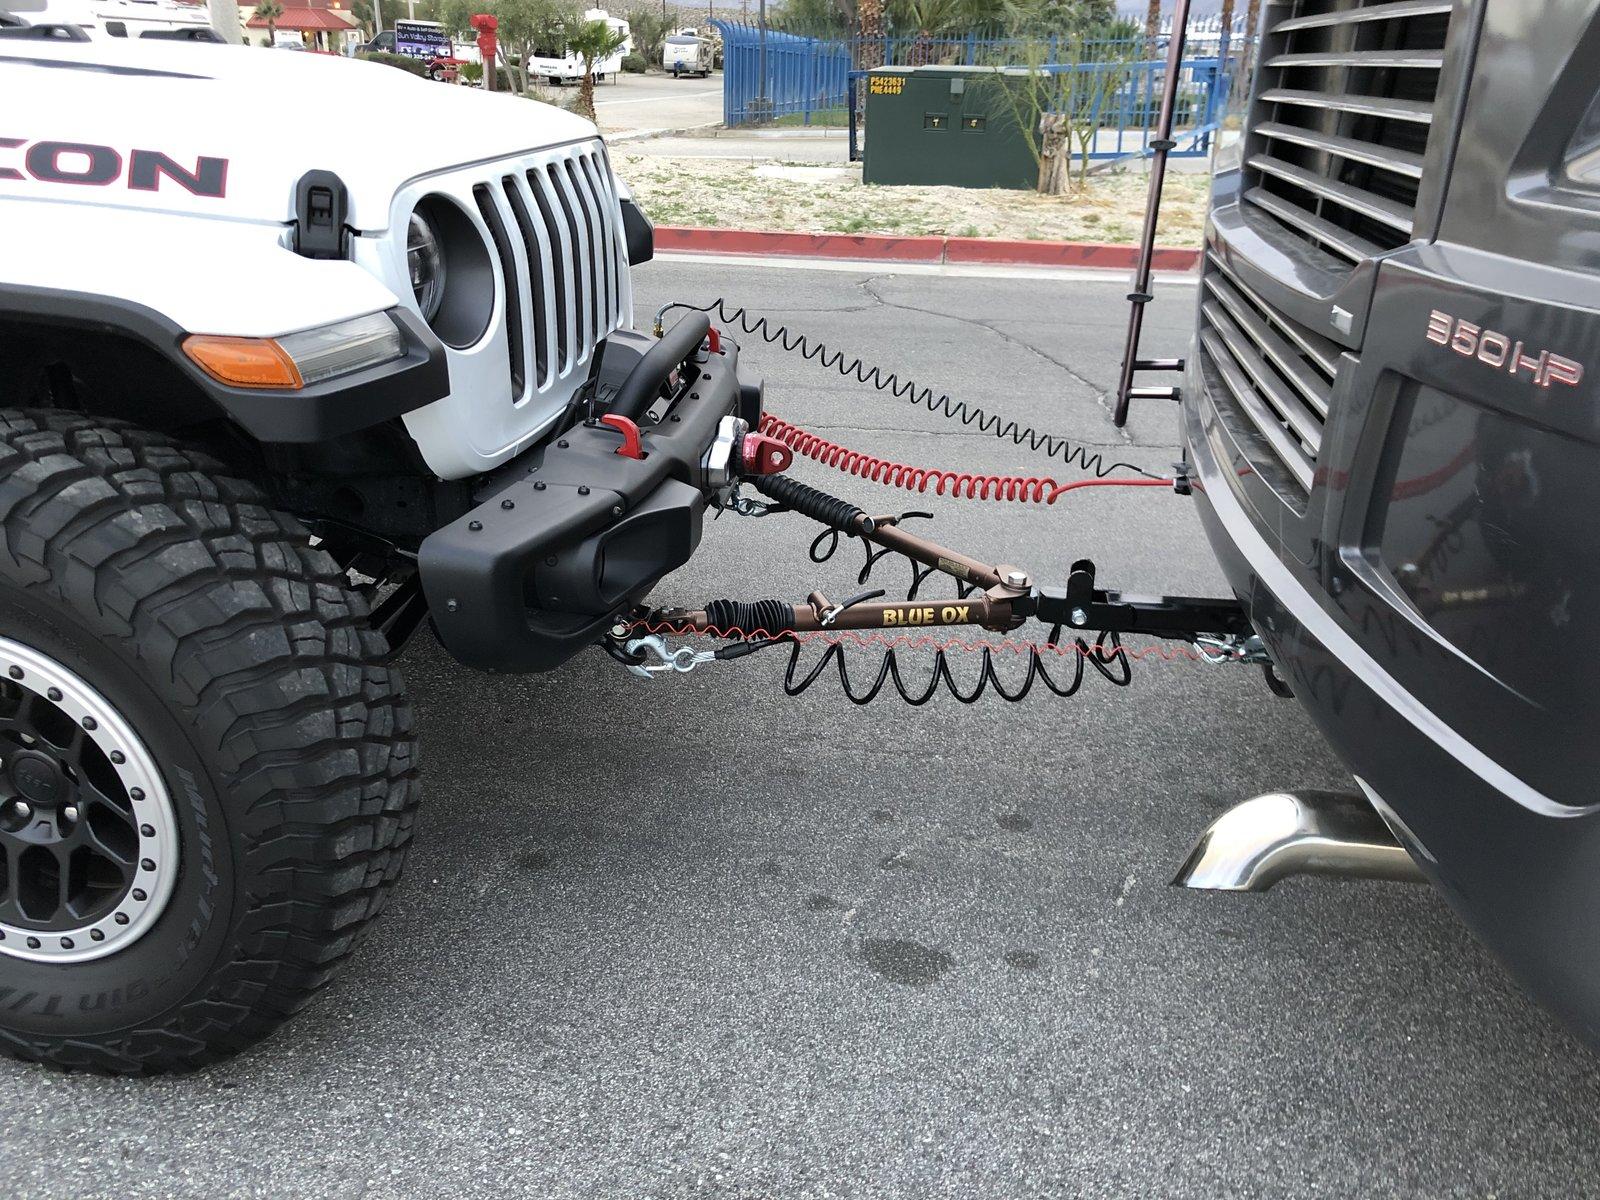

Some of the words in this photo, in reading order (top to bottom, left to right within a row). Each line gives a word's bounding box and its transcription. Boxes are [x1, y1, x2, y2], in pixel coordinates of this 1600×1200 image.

[410, 33, 427, 42] Valley
[883, 608, 935, 626] BLUE
[941, 606, 970, 624] OX
